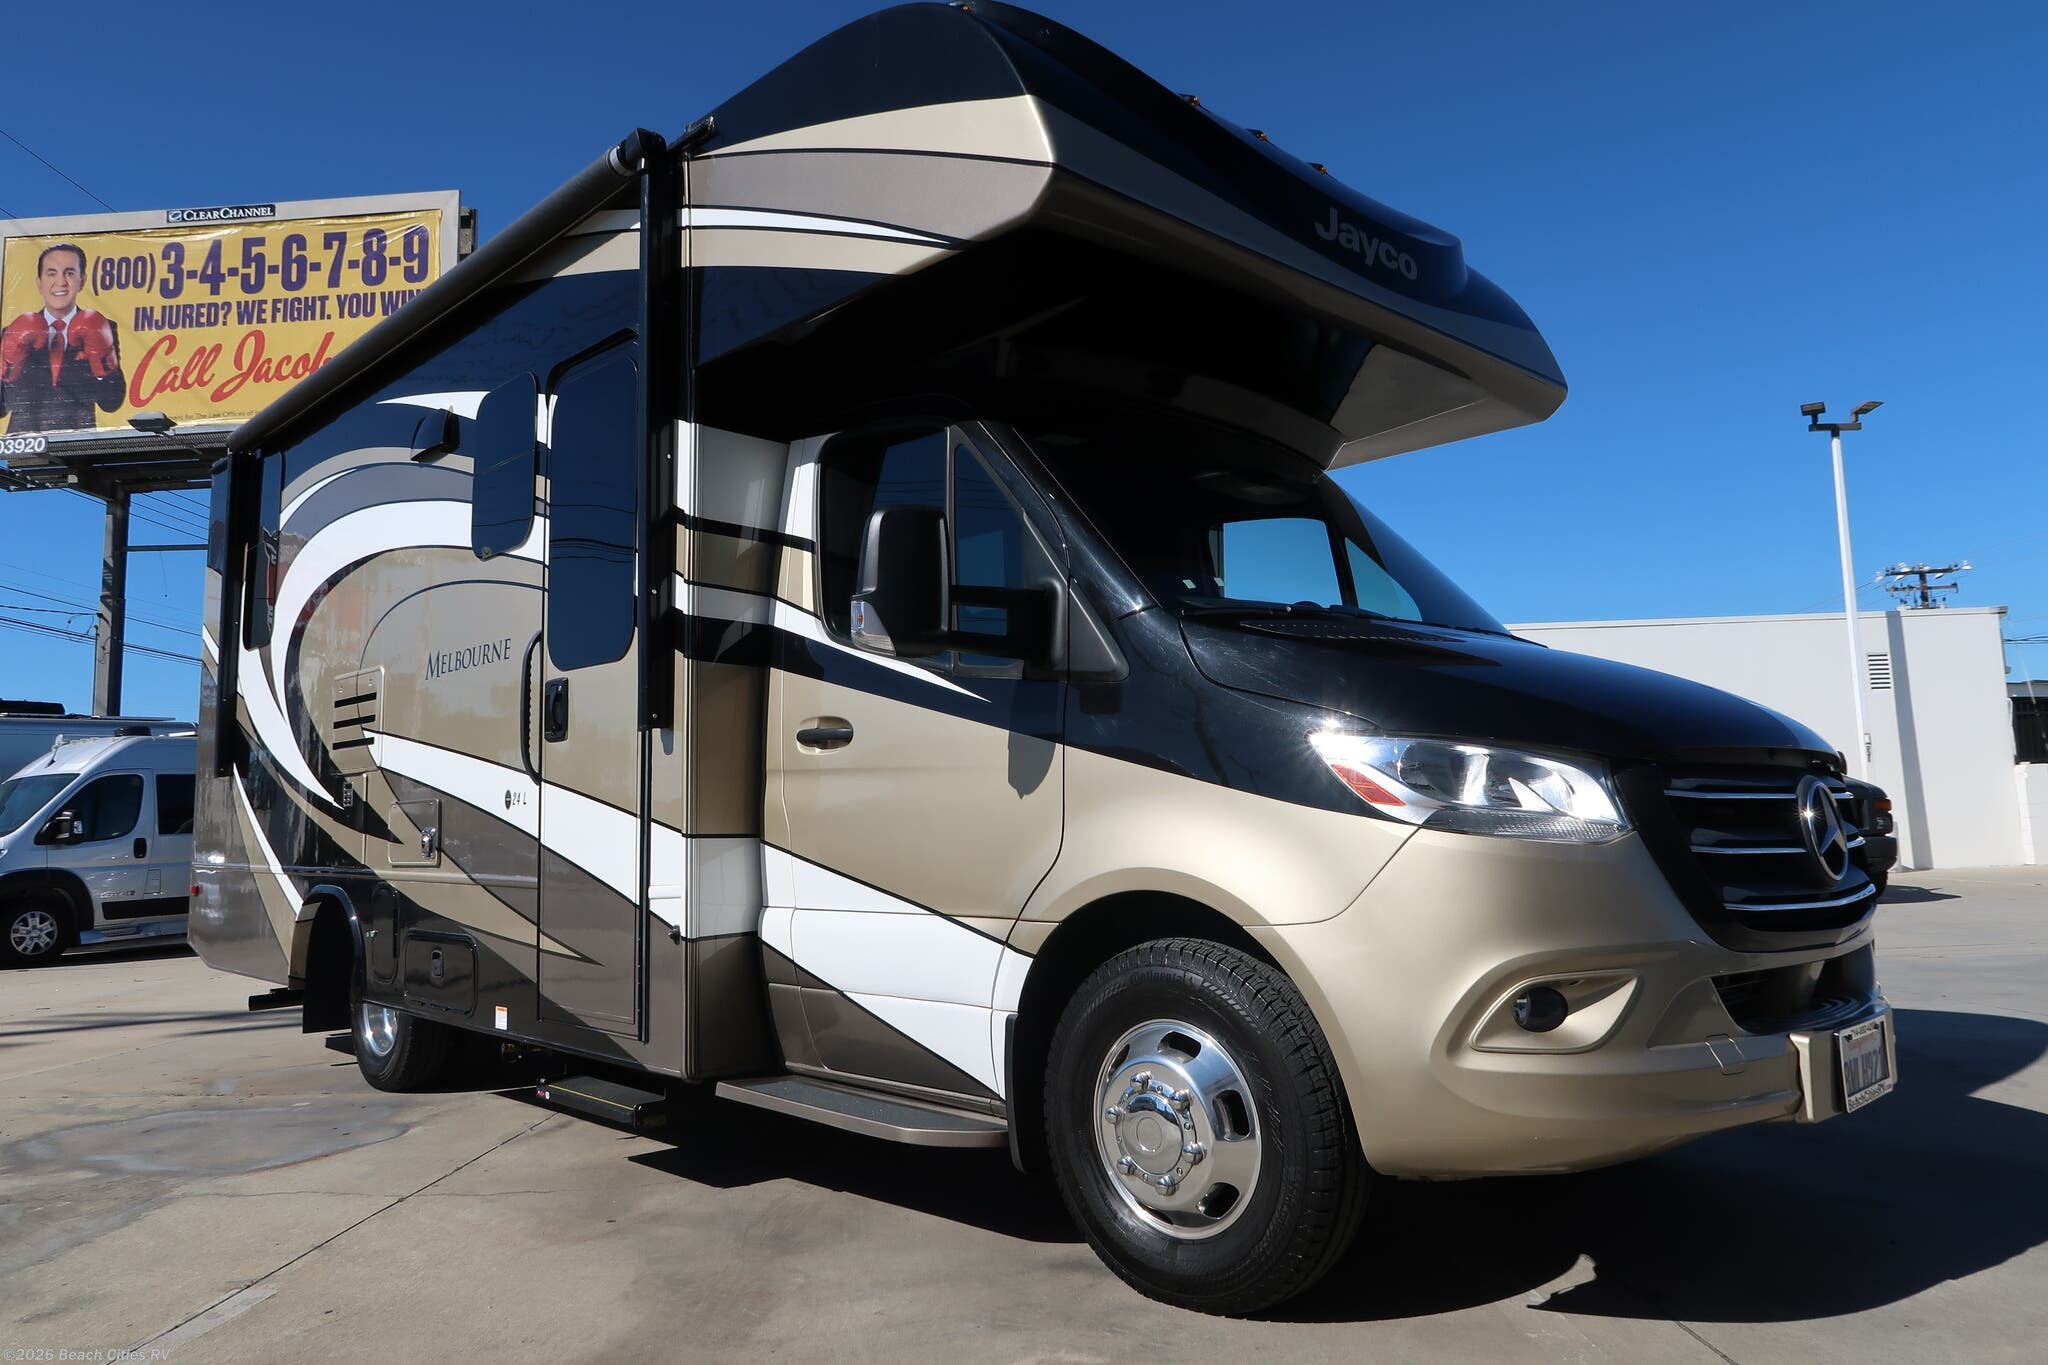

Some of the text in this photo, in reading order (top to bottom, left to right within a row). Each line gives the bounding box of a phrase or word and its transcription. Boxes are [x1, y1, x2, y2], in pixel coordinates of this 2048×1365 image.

[92, 224, 430, 300] (800) 3-4-5-6-7-8-9
[1313, 207, 1418, 280] Jayco
[133, 300, 231, 332] INJURED?
[236, 299, 268, 326] WE
[271, 295, 332, 323] FIGHT.
[336, 291, 376, 319] YOU
[129, 334, 223, 409] Call
[425, 638, 512, 681] MELBOURNE
